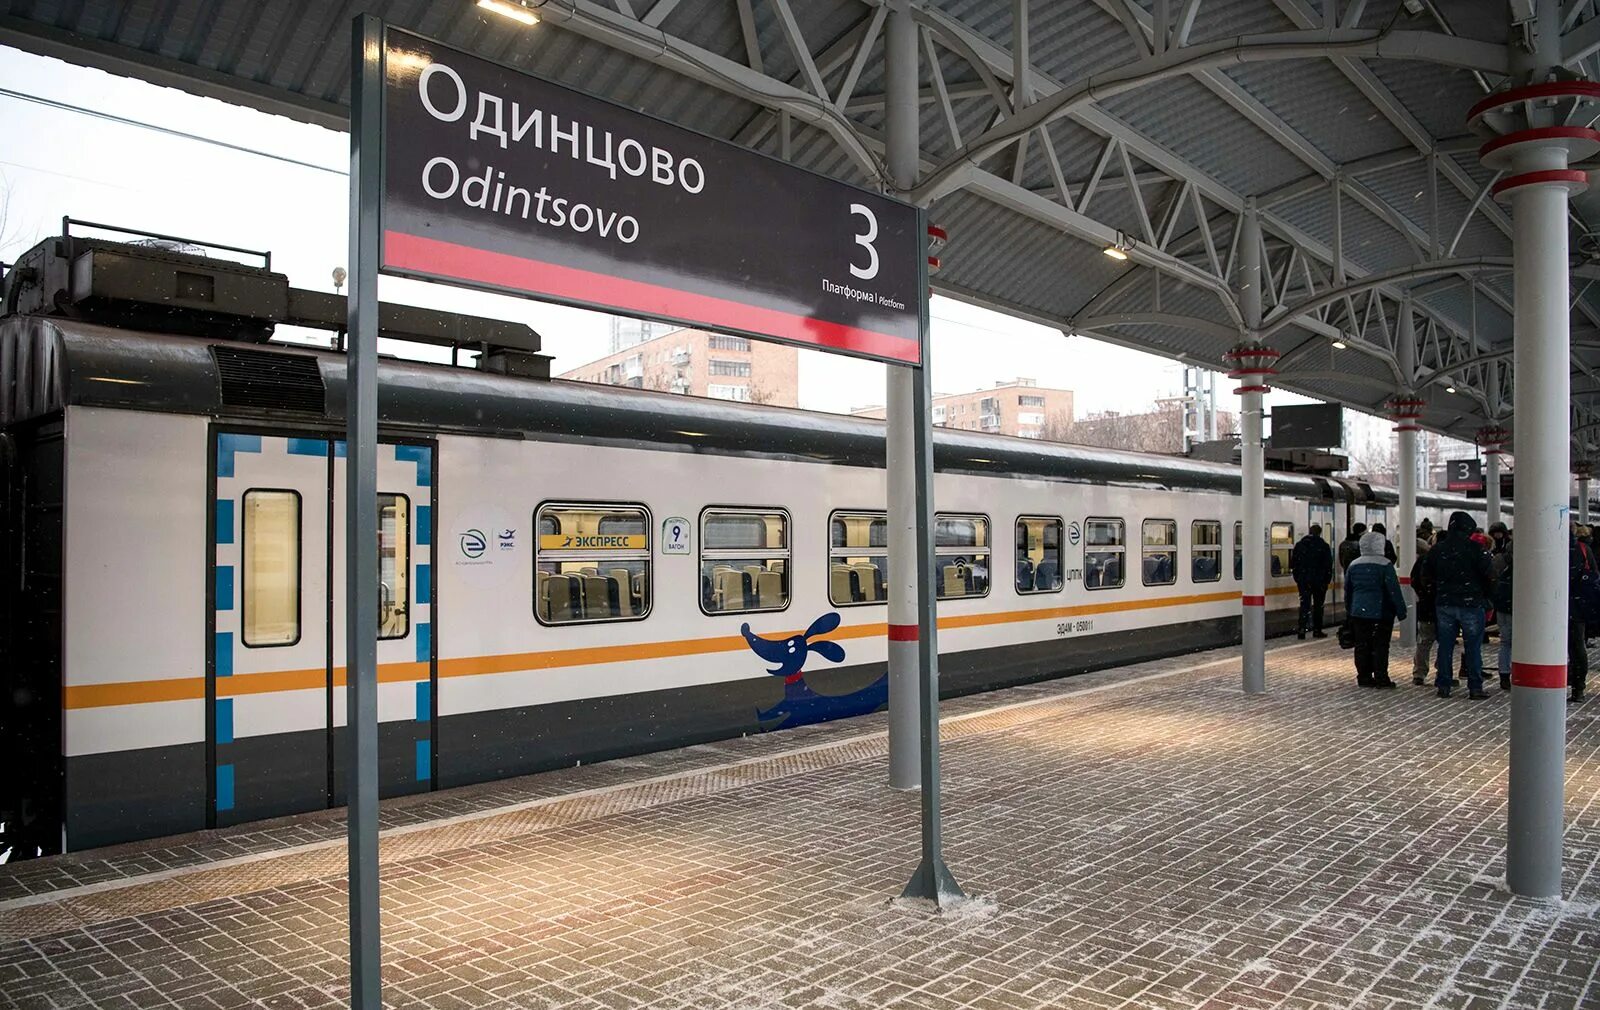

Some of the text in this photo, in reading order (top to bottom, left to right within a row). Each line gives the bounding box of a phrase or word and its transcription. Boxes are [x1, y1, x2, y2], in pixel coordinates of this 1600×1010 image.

[419, 63, 706, 194] Одинцово
[421, 157, 641, 243] Odintsovo
[849, 203, 880, 279] 3
[822, 279, 905, 310] Платформа Platform
[1458, 463, 1470, 480] 3
[575, 536, 629, 547] ЭКСПРЕСС
[672, 525, 681, 542] 9
